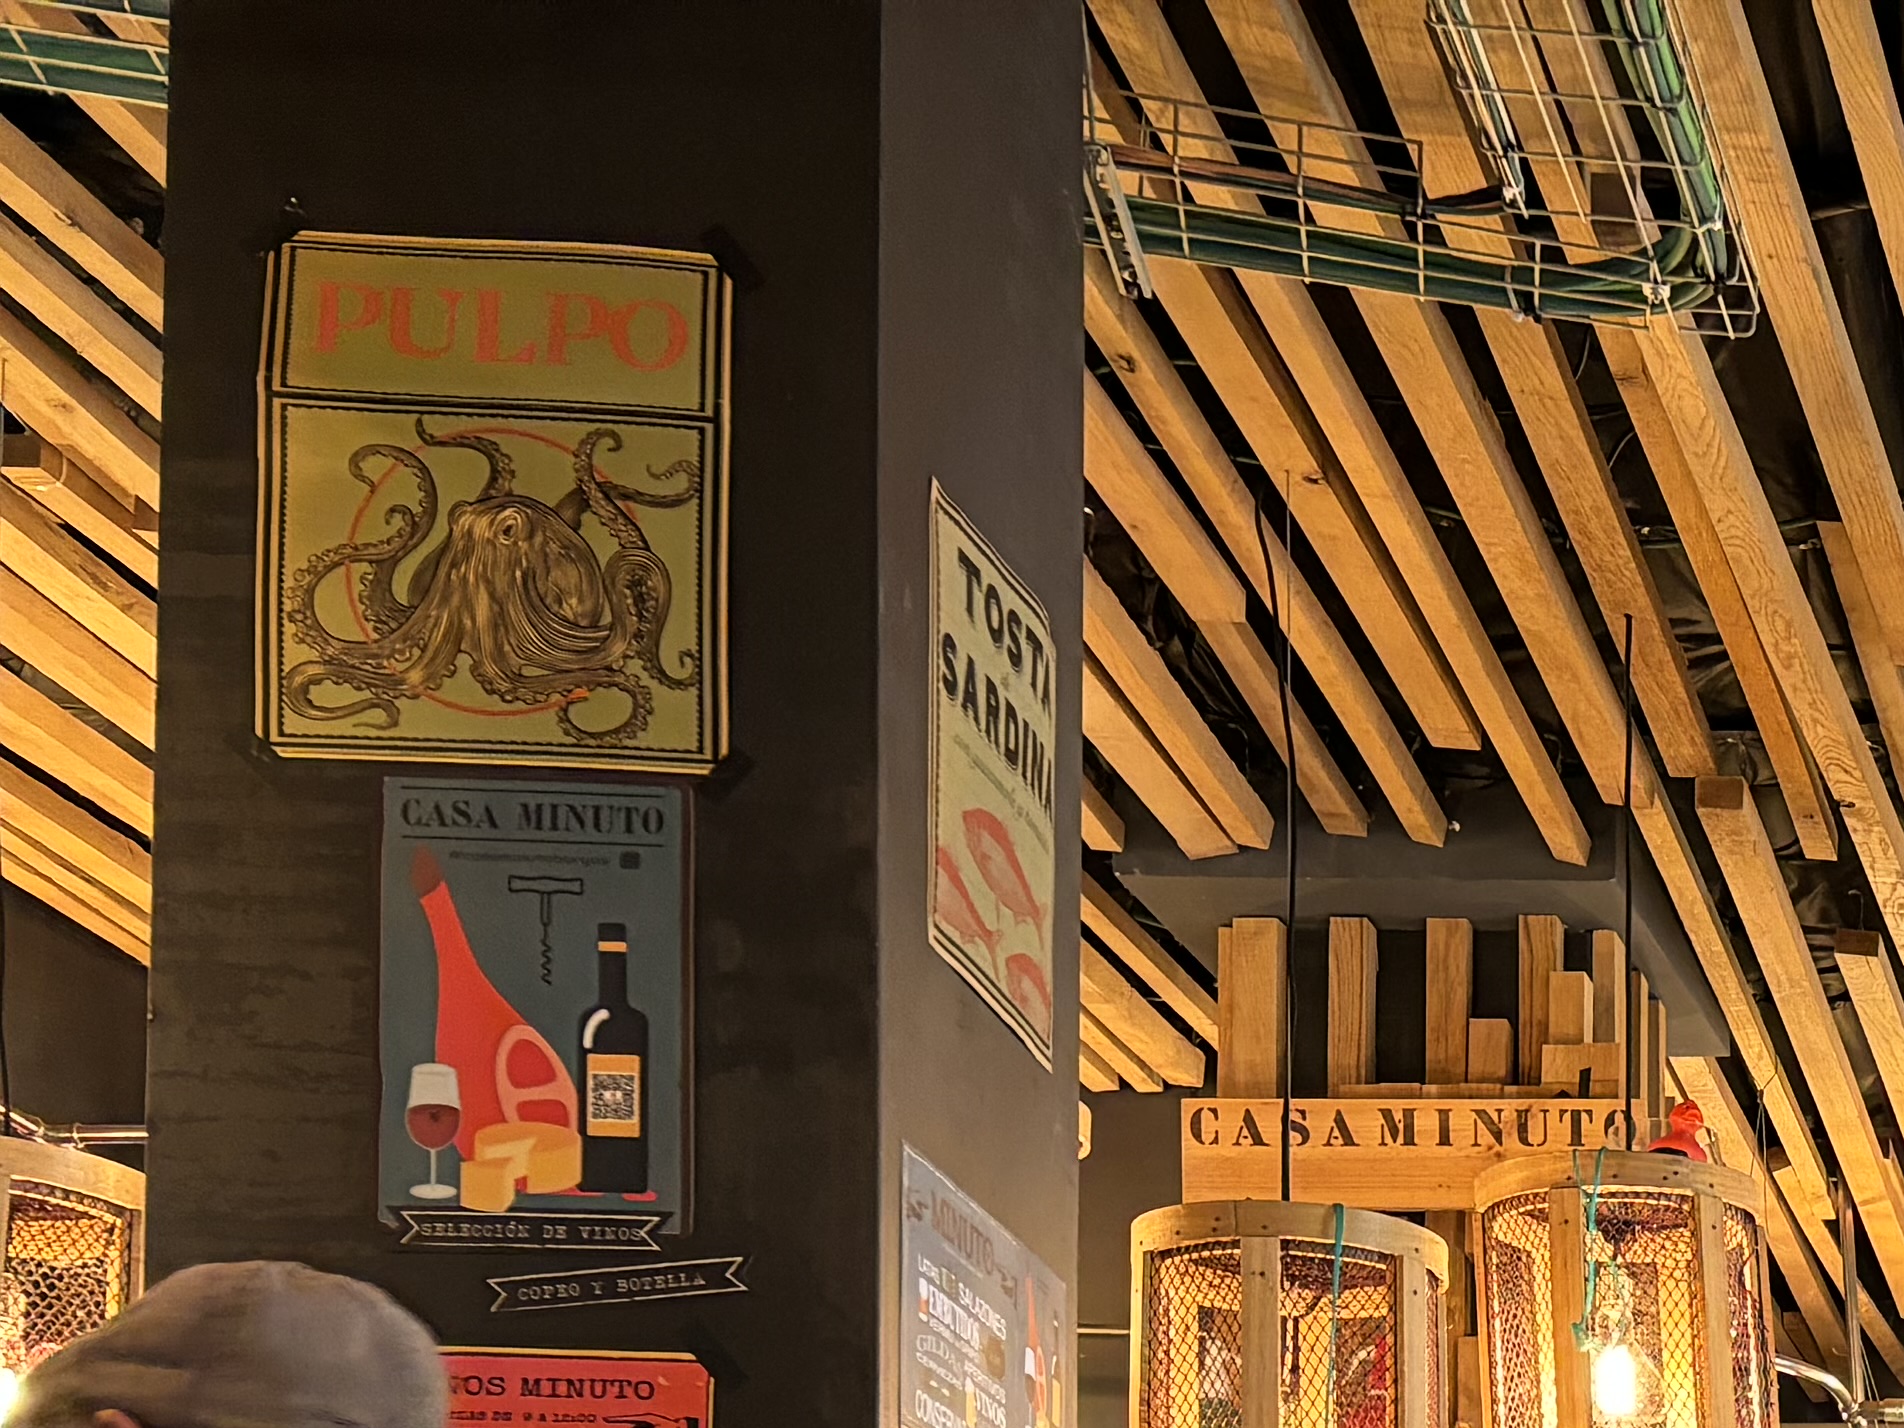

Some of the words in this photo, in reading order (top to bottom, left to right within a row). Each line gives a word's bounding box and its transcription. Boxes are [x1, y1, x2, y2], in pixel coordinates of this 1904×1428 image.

[313, 280, 688, 370] PULPO
[402, 799, 499, 829] CASA
[518, 803, 664, 834] MINUTO
[420, 1221, 530, 1238] SELECCIÓN
[543, 1225, 568, 1239] DE
[579, 1226, 643, 1240] VINOS
[616, 1273, 706, 1293] BOTELLA
[520, 1377, 655, 1400] MINUTO
